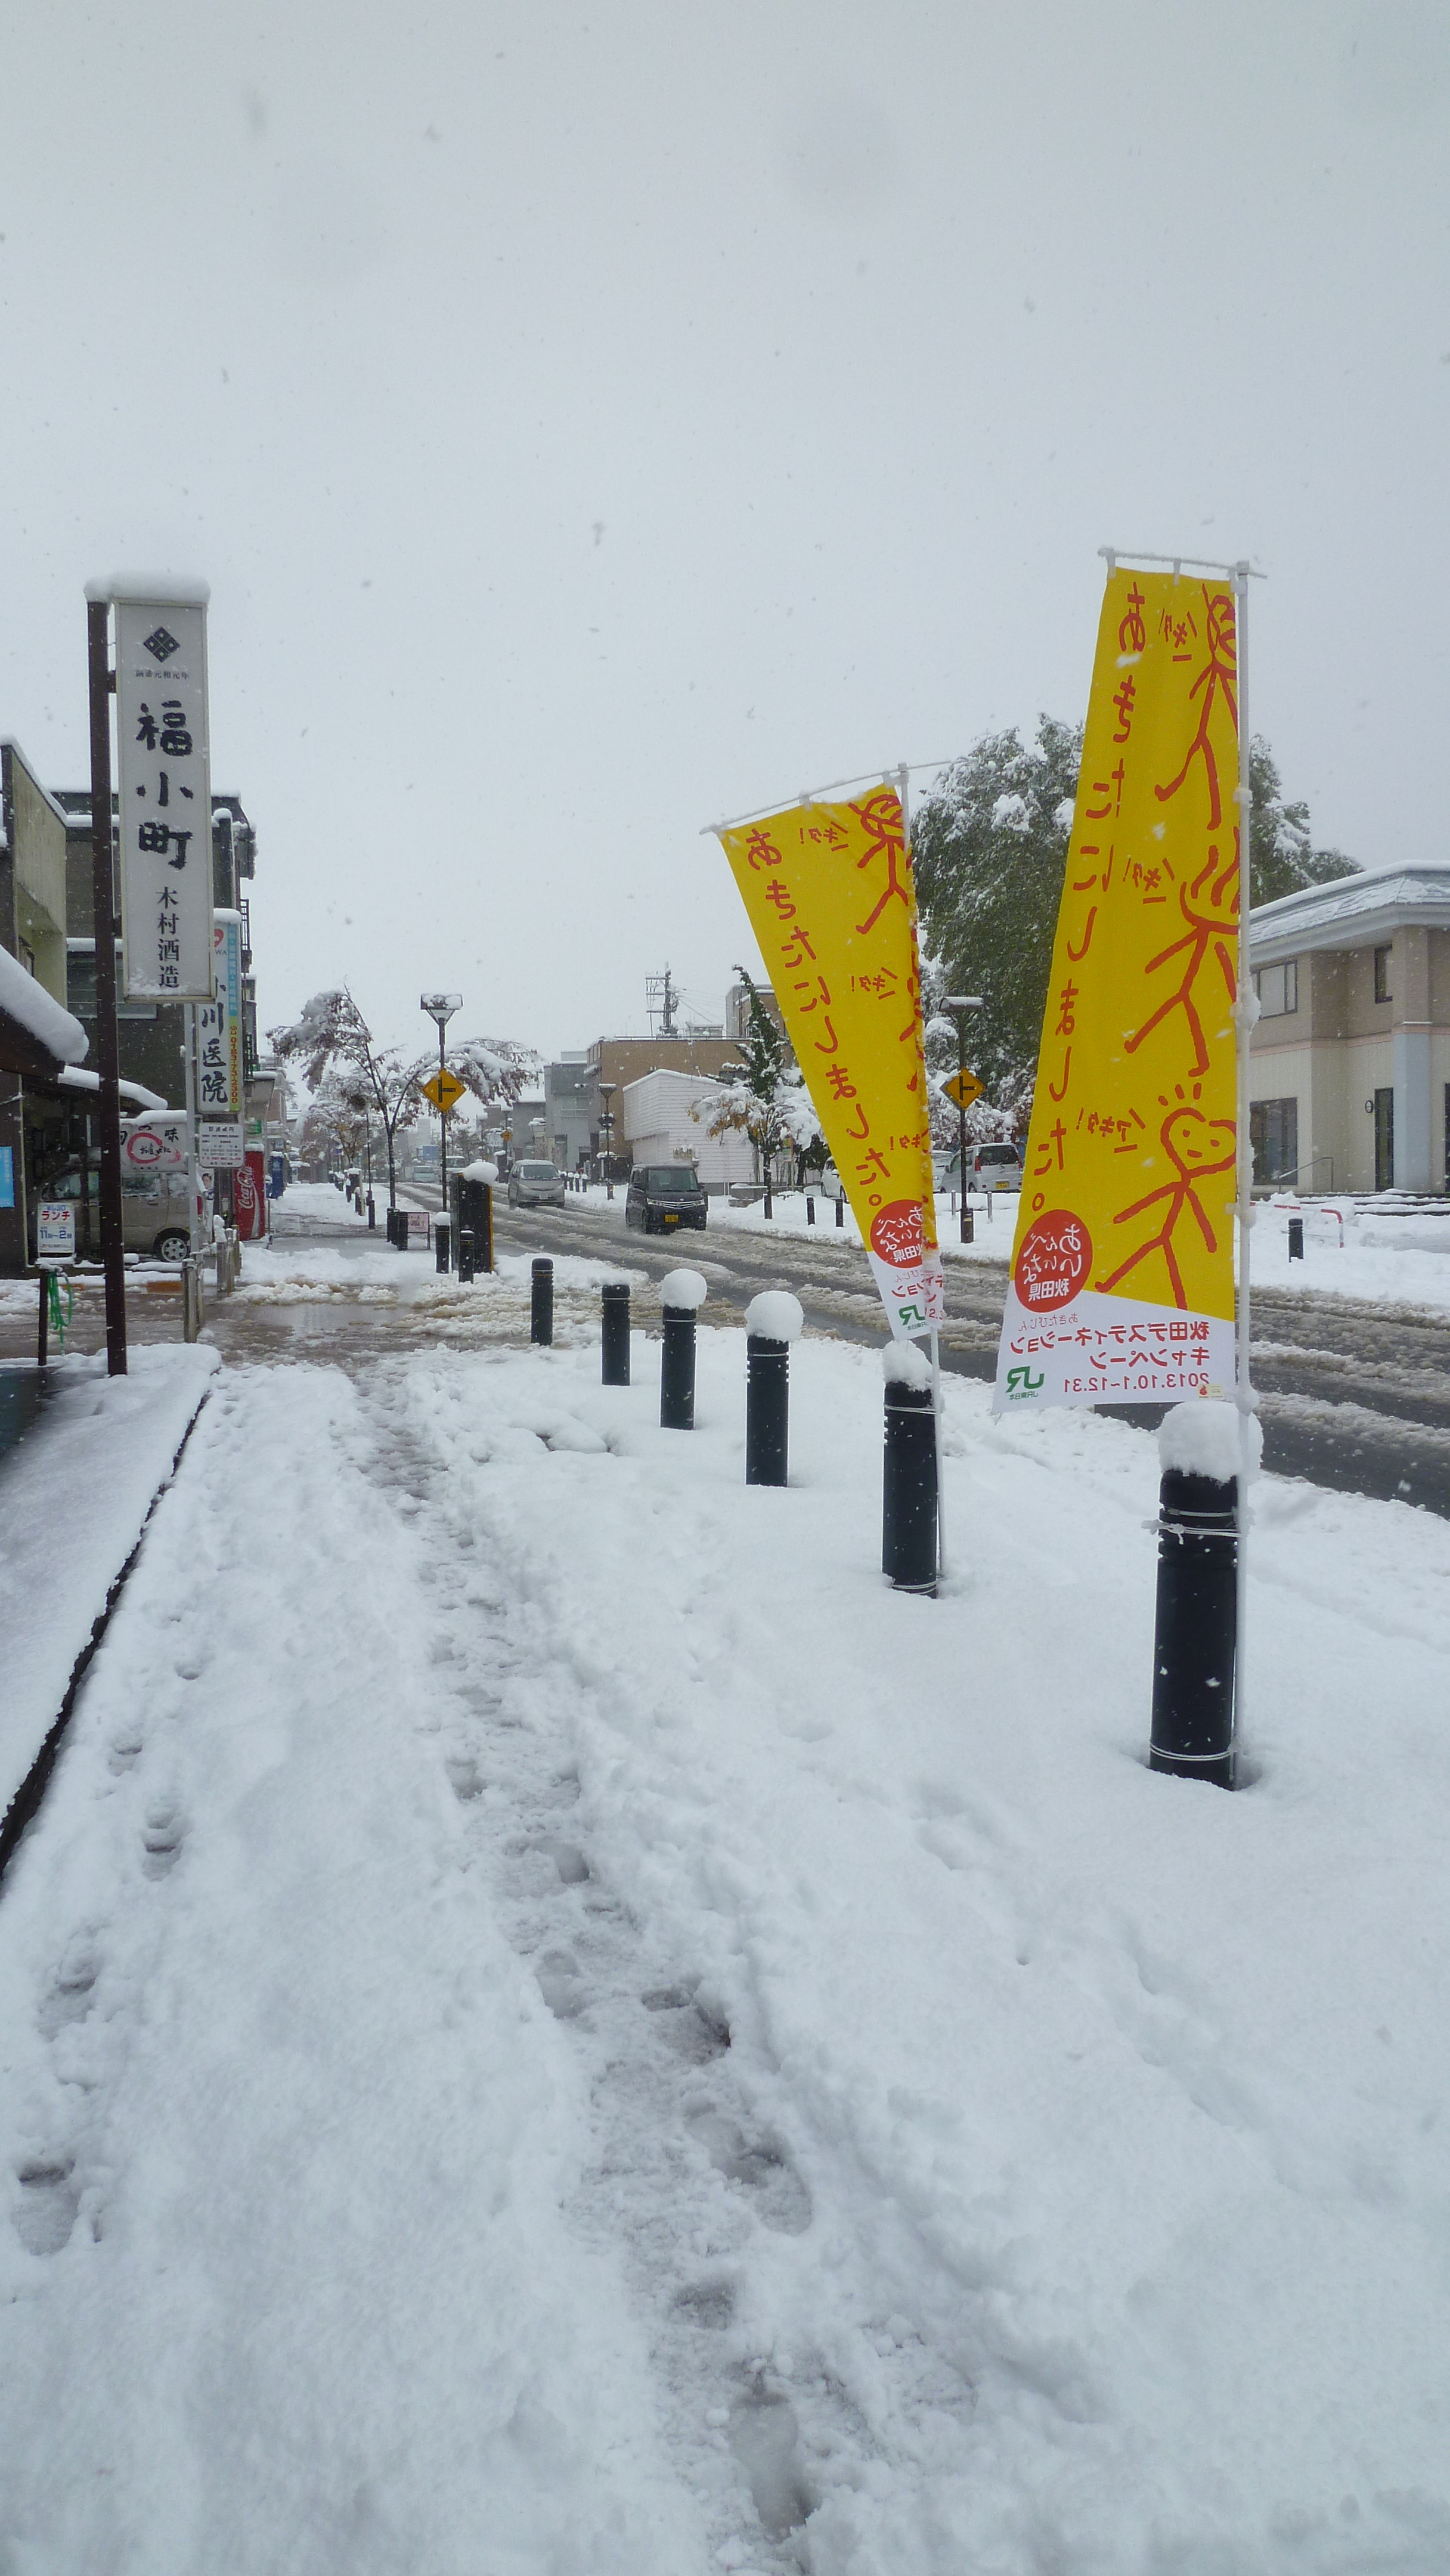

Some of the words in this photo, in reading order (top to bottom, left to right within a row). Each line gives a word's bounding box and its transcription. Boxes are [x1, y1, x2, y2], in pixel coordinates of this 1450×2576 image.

[136, 700, 194, 870] 福小町
[156, 887, 179, 988] 木村酒造
[42, 1210, 70, 1221] ランチ
[237, 1166, 253, 1209] Coca-Cola
